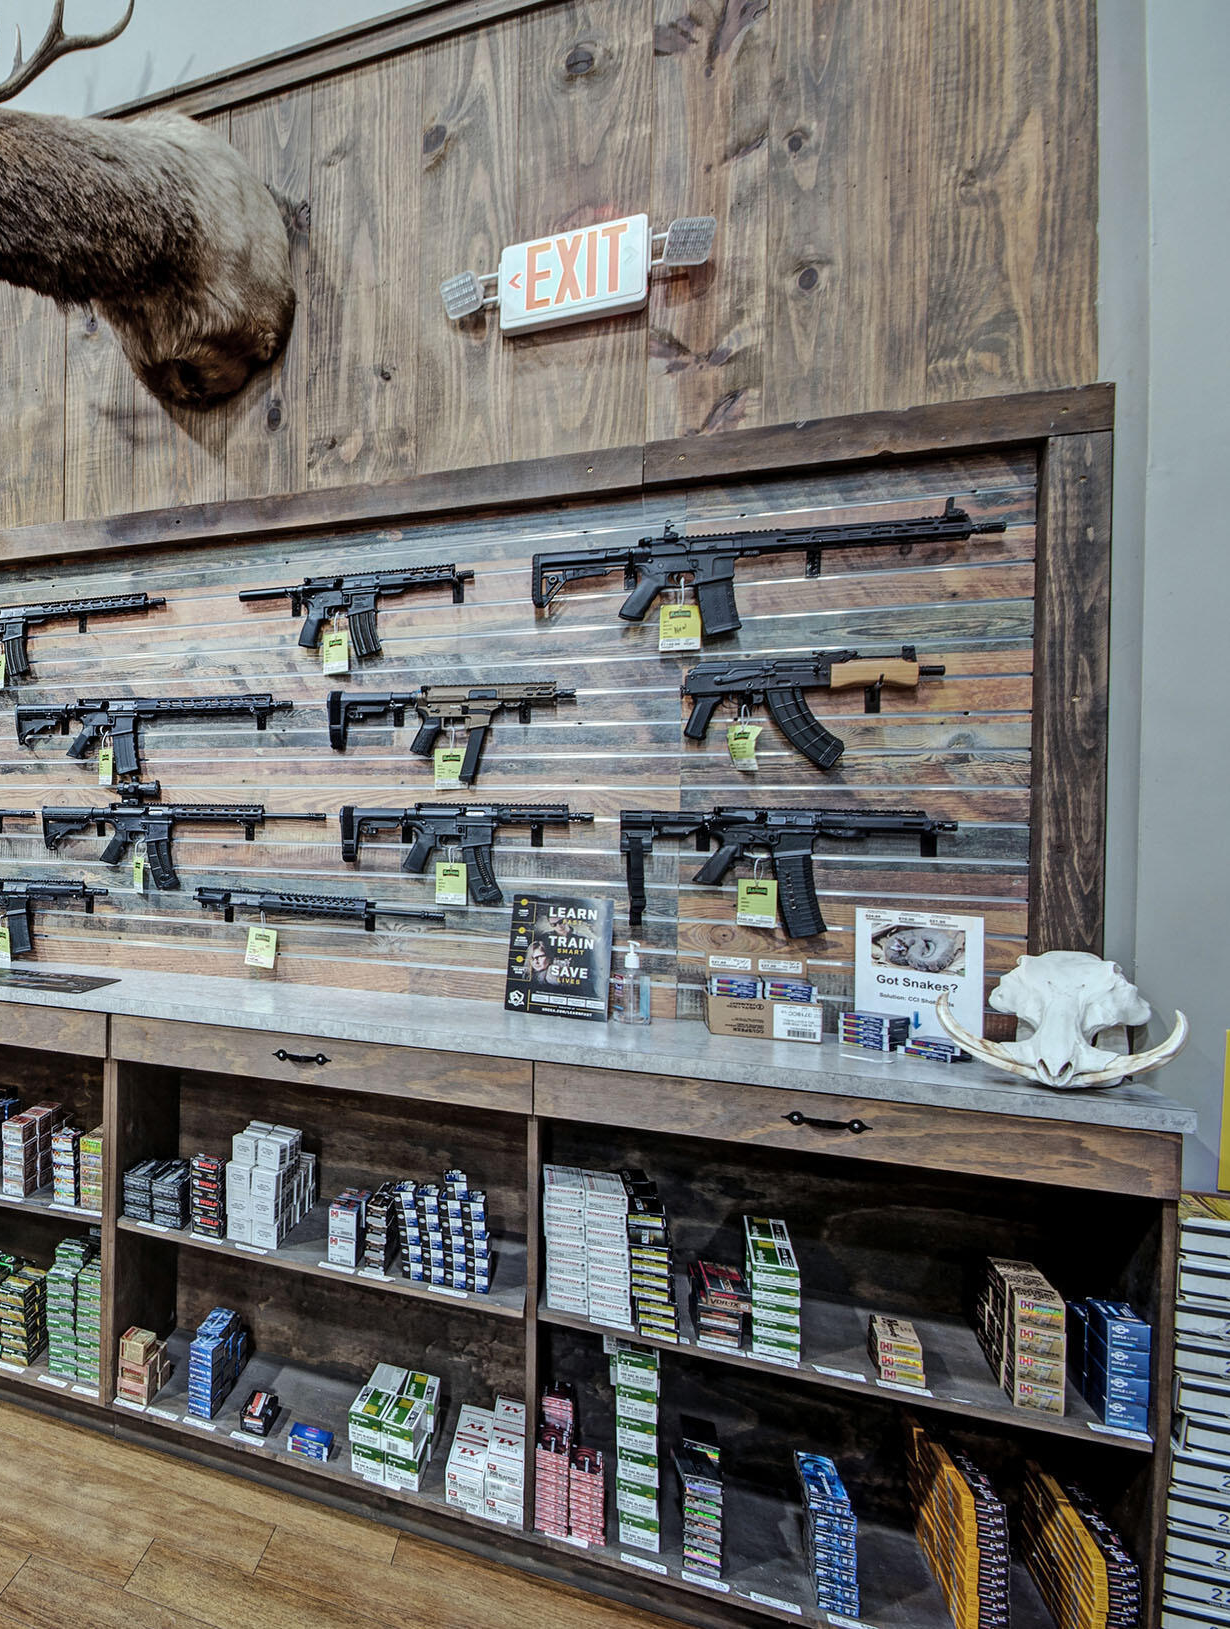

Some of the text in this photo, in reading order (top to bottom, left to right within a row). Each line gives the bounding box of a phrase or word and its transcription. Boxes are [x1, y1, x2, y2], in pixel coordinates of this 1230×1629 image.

[525, 222, 628, 311] EXIT
[548, 906, 598, 920] LEARN
[548, 935, 594, 950] TRAIN
[557, 948, 585, 956] SMART
[551, 965, 589, 979] SAVE
[876, 974, 959, 993] Got Snakes?
[879, 992, 907, 1001] Solution:
[198, 1162, 218, 1170] WOLF
[199, 1180, 218, 1189] WOLF
[200, 1199, 218, 1207] WOLF
[200, 1217, 219, 1226] WOLF
[1218, 1514, 1229, 1527] 2
[1216, 1550, 1227, 1564] 2
